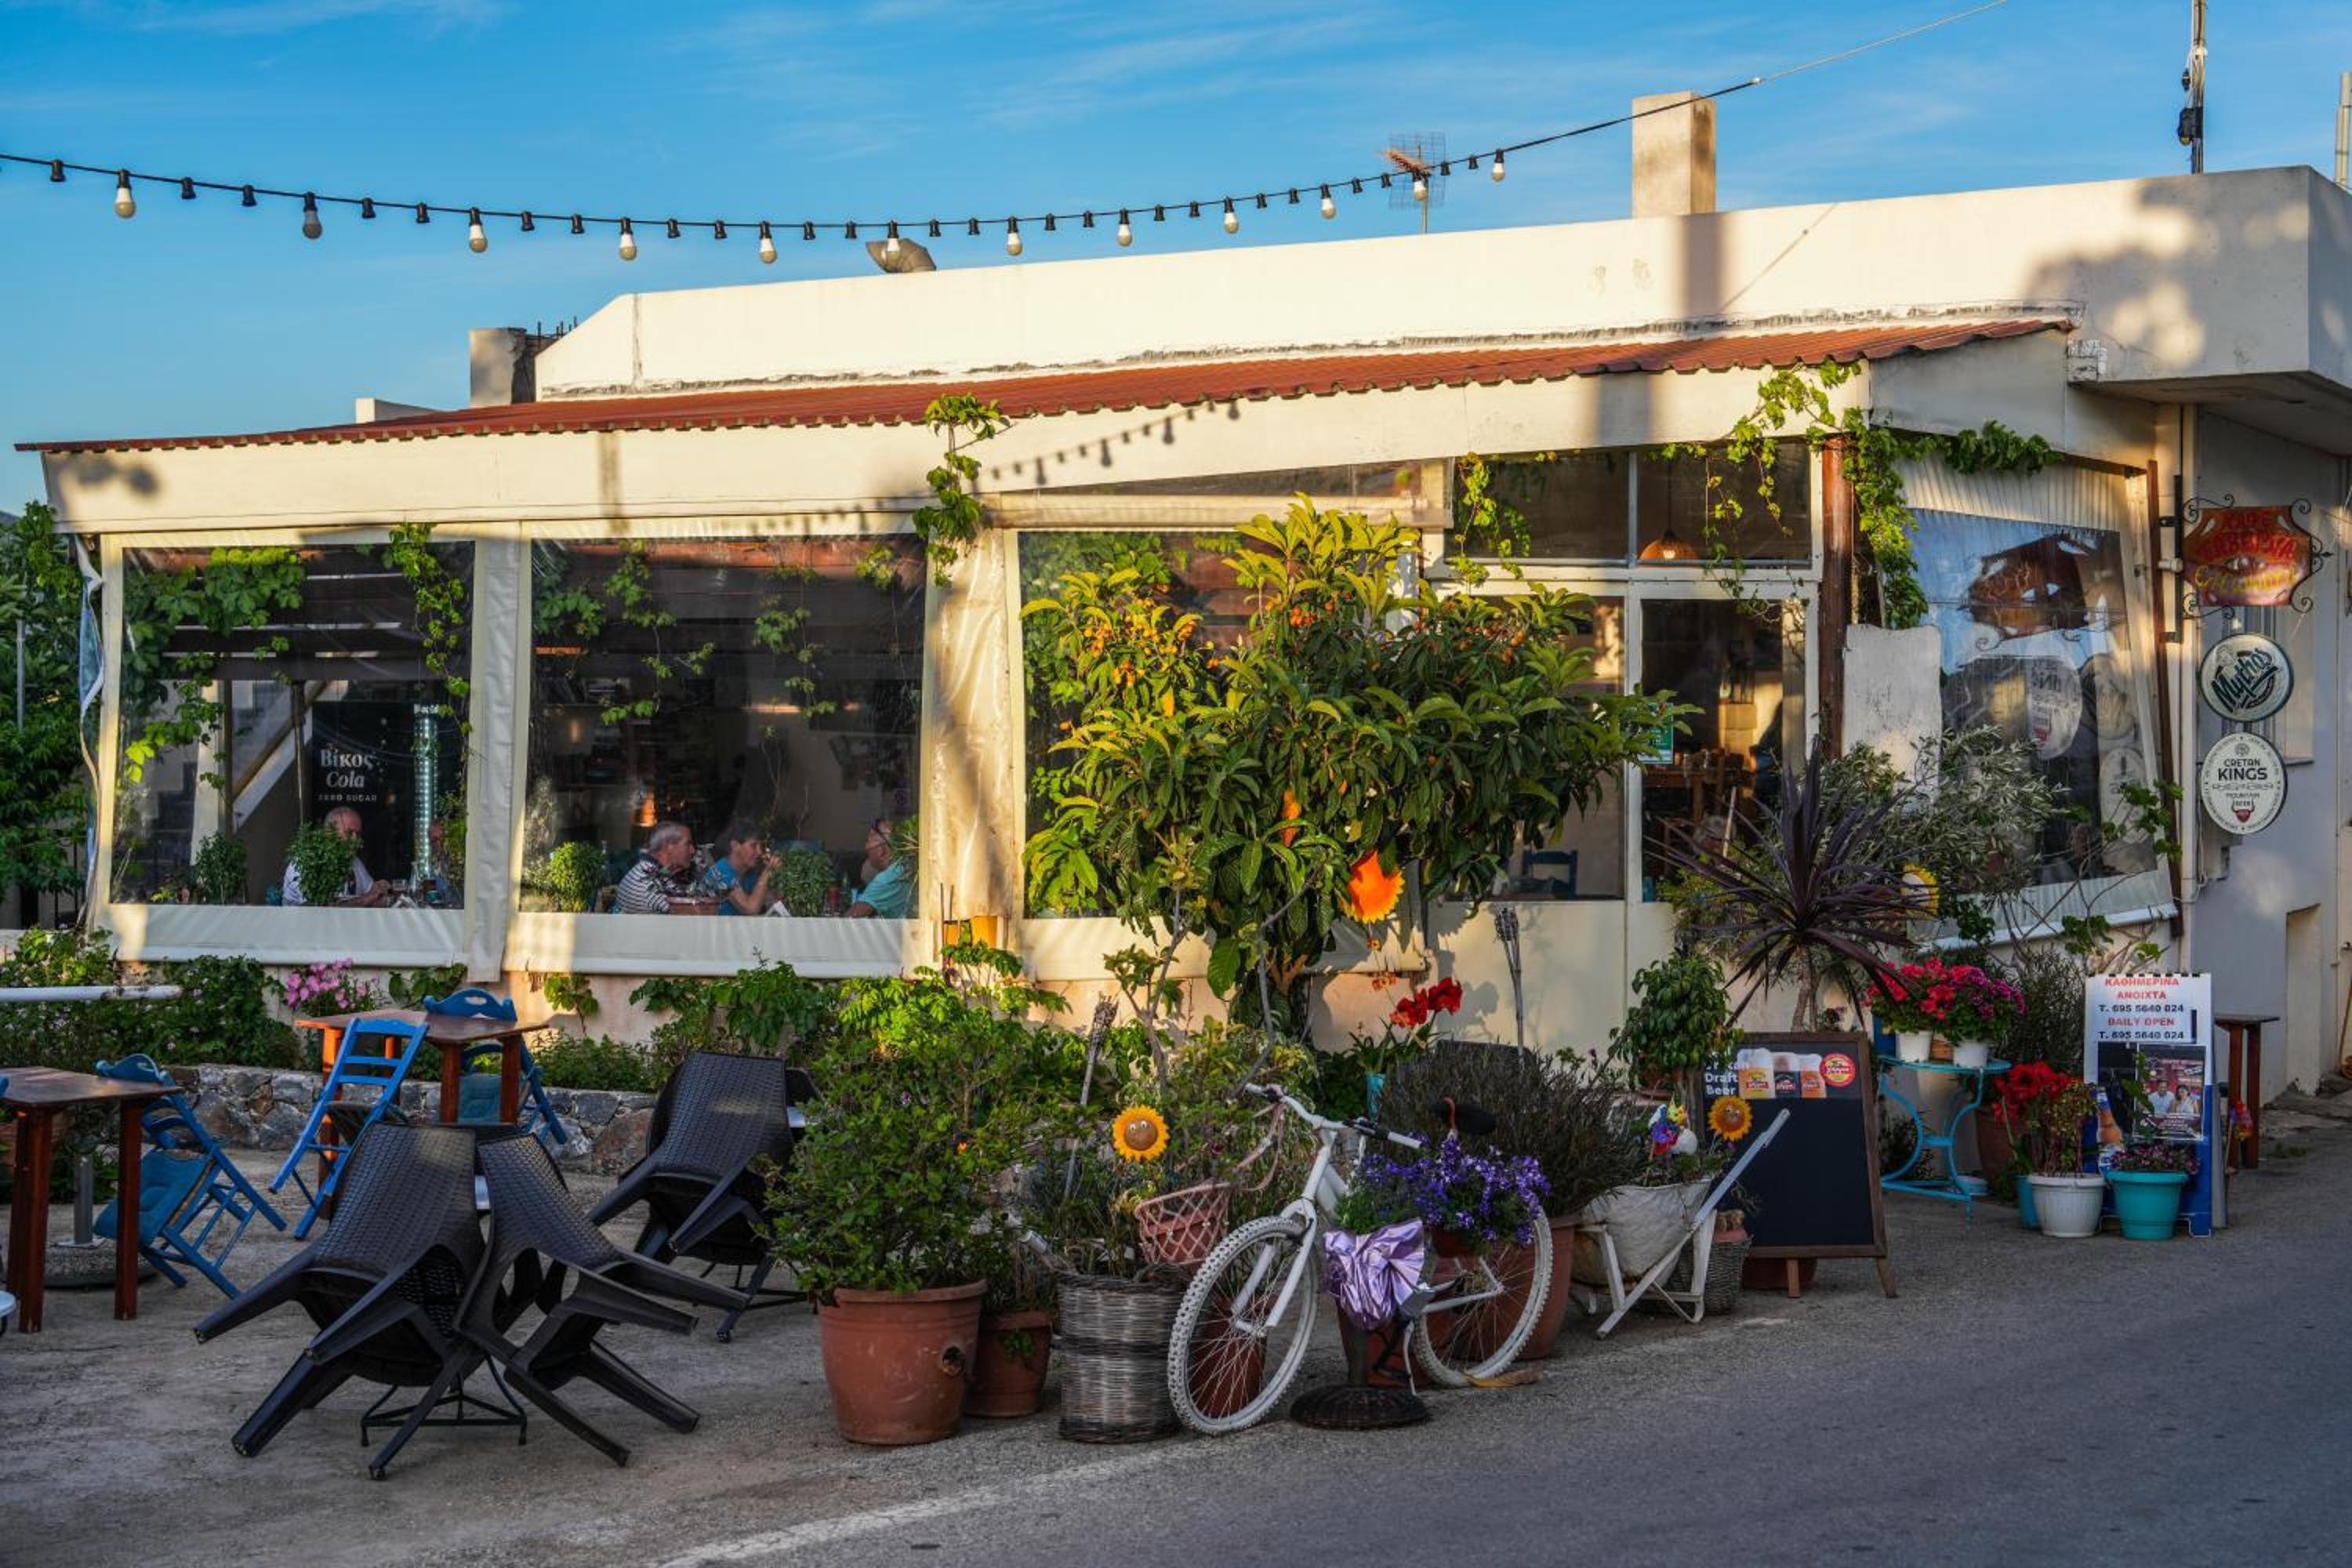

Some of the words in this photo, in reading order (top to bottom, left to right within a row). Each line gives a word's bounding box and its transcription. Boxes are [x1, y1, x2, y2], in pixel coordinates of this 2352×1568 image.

[2211, 648, 2273, 713] Mythos
[2223, 758, 2260, 768] CRETAN
[326, 771, 365, 788] Cola
[2218, 768, 2268, 781] KINGS
[2105, 978, 2180, 986] ΚΑΘΗΜΕΡΙΝΑ
[2117, 990, 2167, 1000] ΑΝΟΙΧΤΑ
[2107, 1017, 2140, 1026] DAILY
[2144, 1017, 2175, 1026] OPEN
[1704, 1072, 1738, 1083] Draft
[1705, 1084, 1737, 1095] Beer
